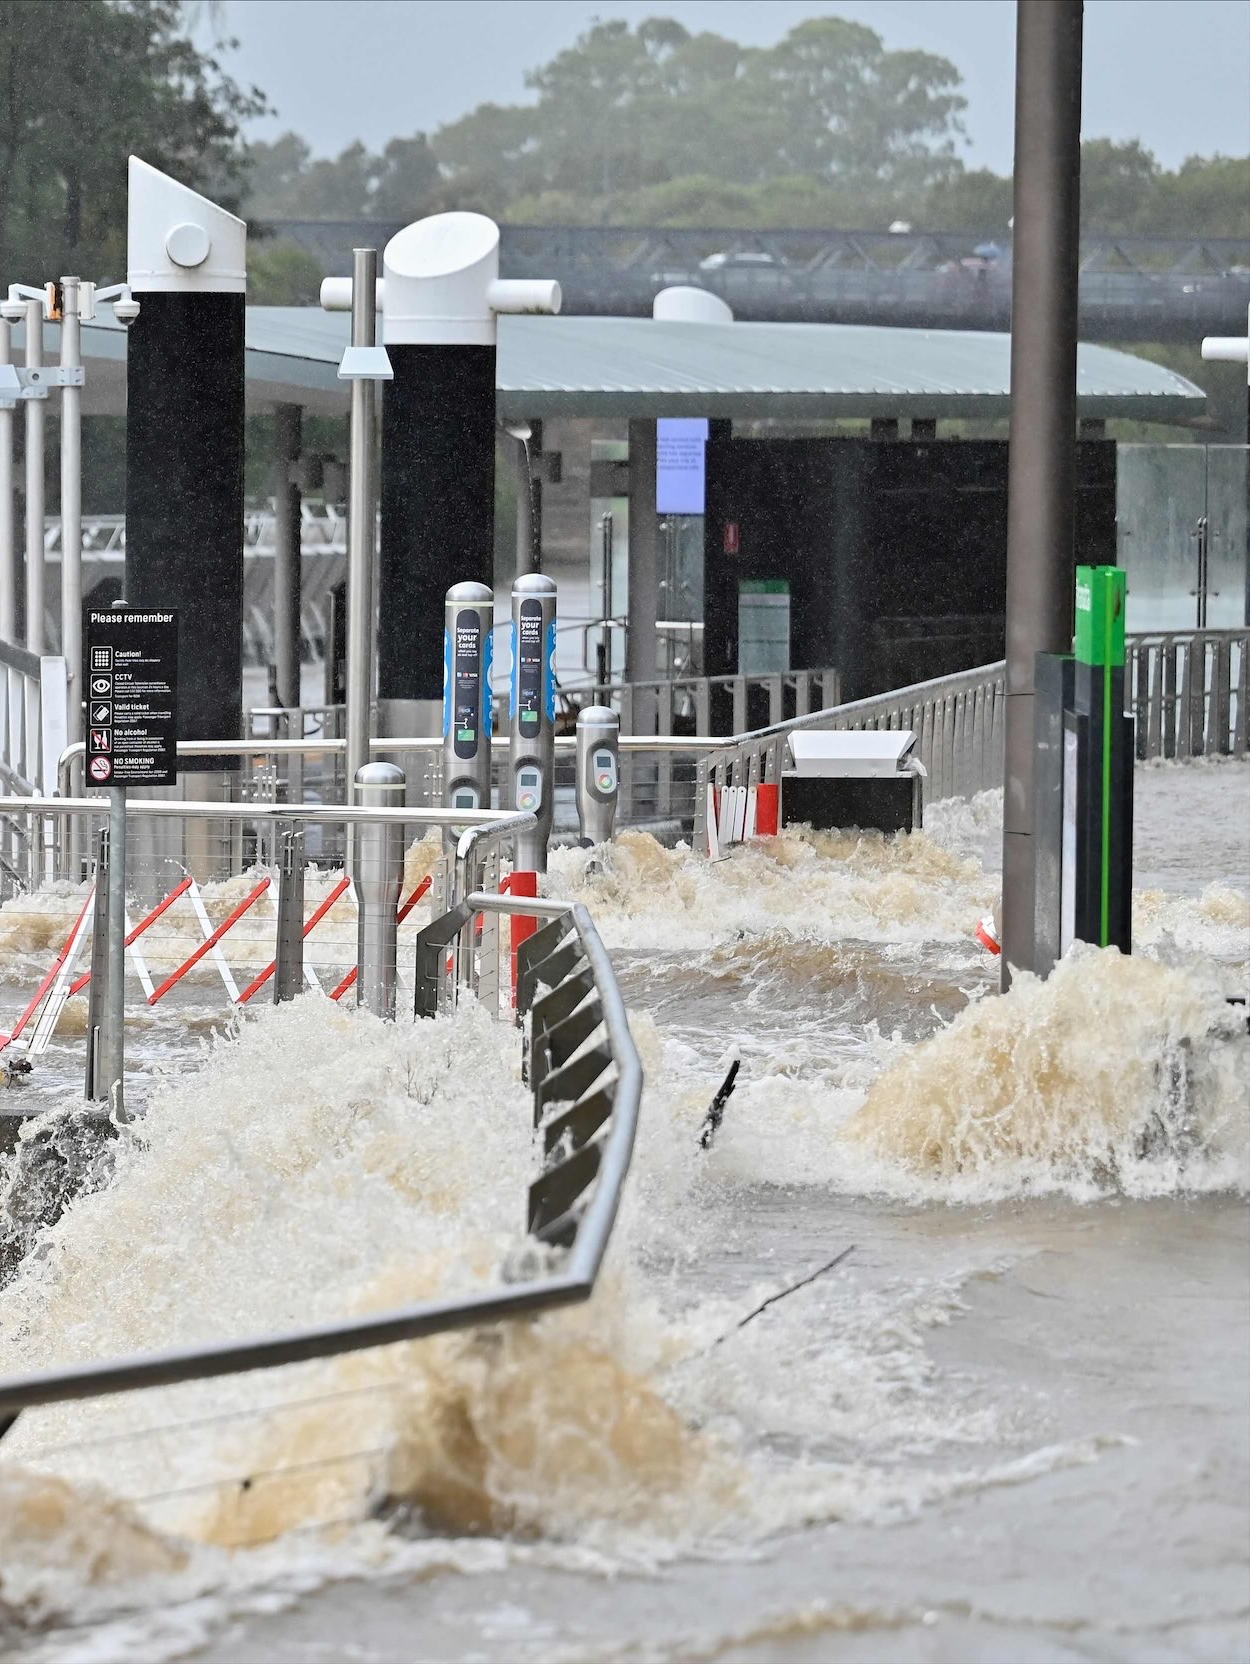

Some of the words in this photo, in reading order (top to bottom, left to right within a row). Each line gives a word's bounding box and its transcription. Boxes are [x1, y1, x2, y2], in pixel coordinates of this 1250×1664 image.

[91, 613, 122, 623] Please
[124, 613, 174, 623] remember
[521, 622, 539, 630] your
[457, 634, 477, 643] your
[458, 641, 476, 649] cards
[124, 728, 147, 736] alcohol
[124, 757, 155, 765] SMOKING
